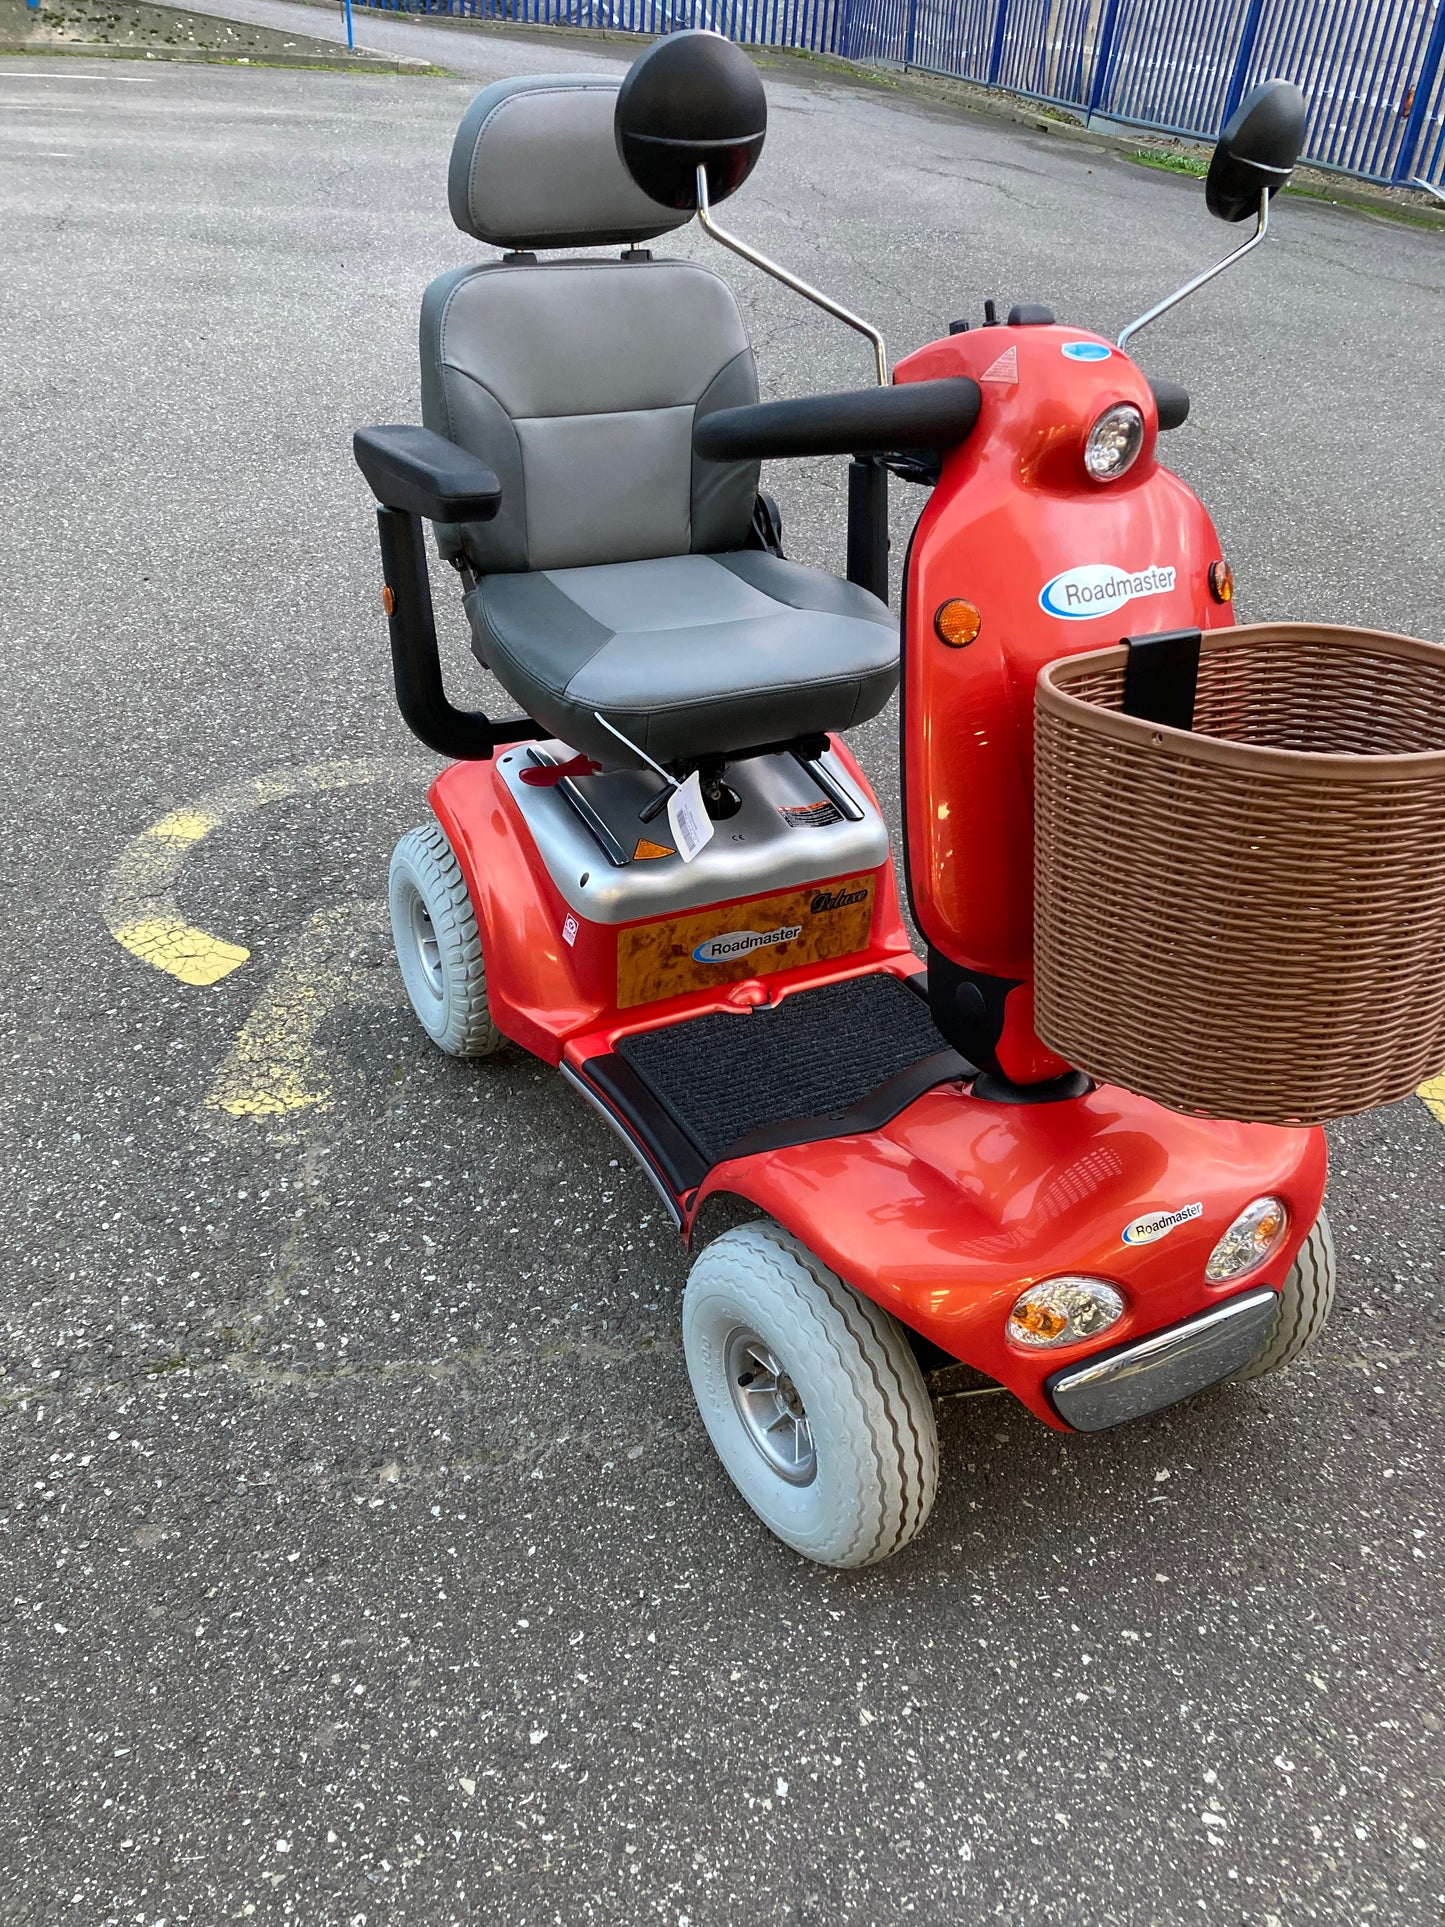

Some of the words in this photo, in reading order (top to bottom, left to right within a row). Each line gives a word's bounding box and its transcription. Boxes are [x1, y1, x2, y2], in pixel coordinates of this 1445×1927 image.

[1064, 570, 1174, 606] Roadmaster
[812, 888, 867, 912] Deluxe
[711, 927, 801, 956] Roadmaster
[1135, 1204, 1201, 1237] Roadmaster
